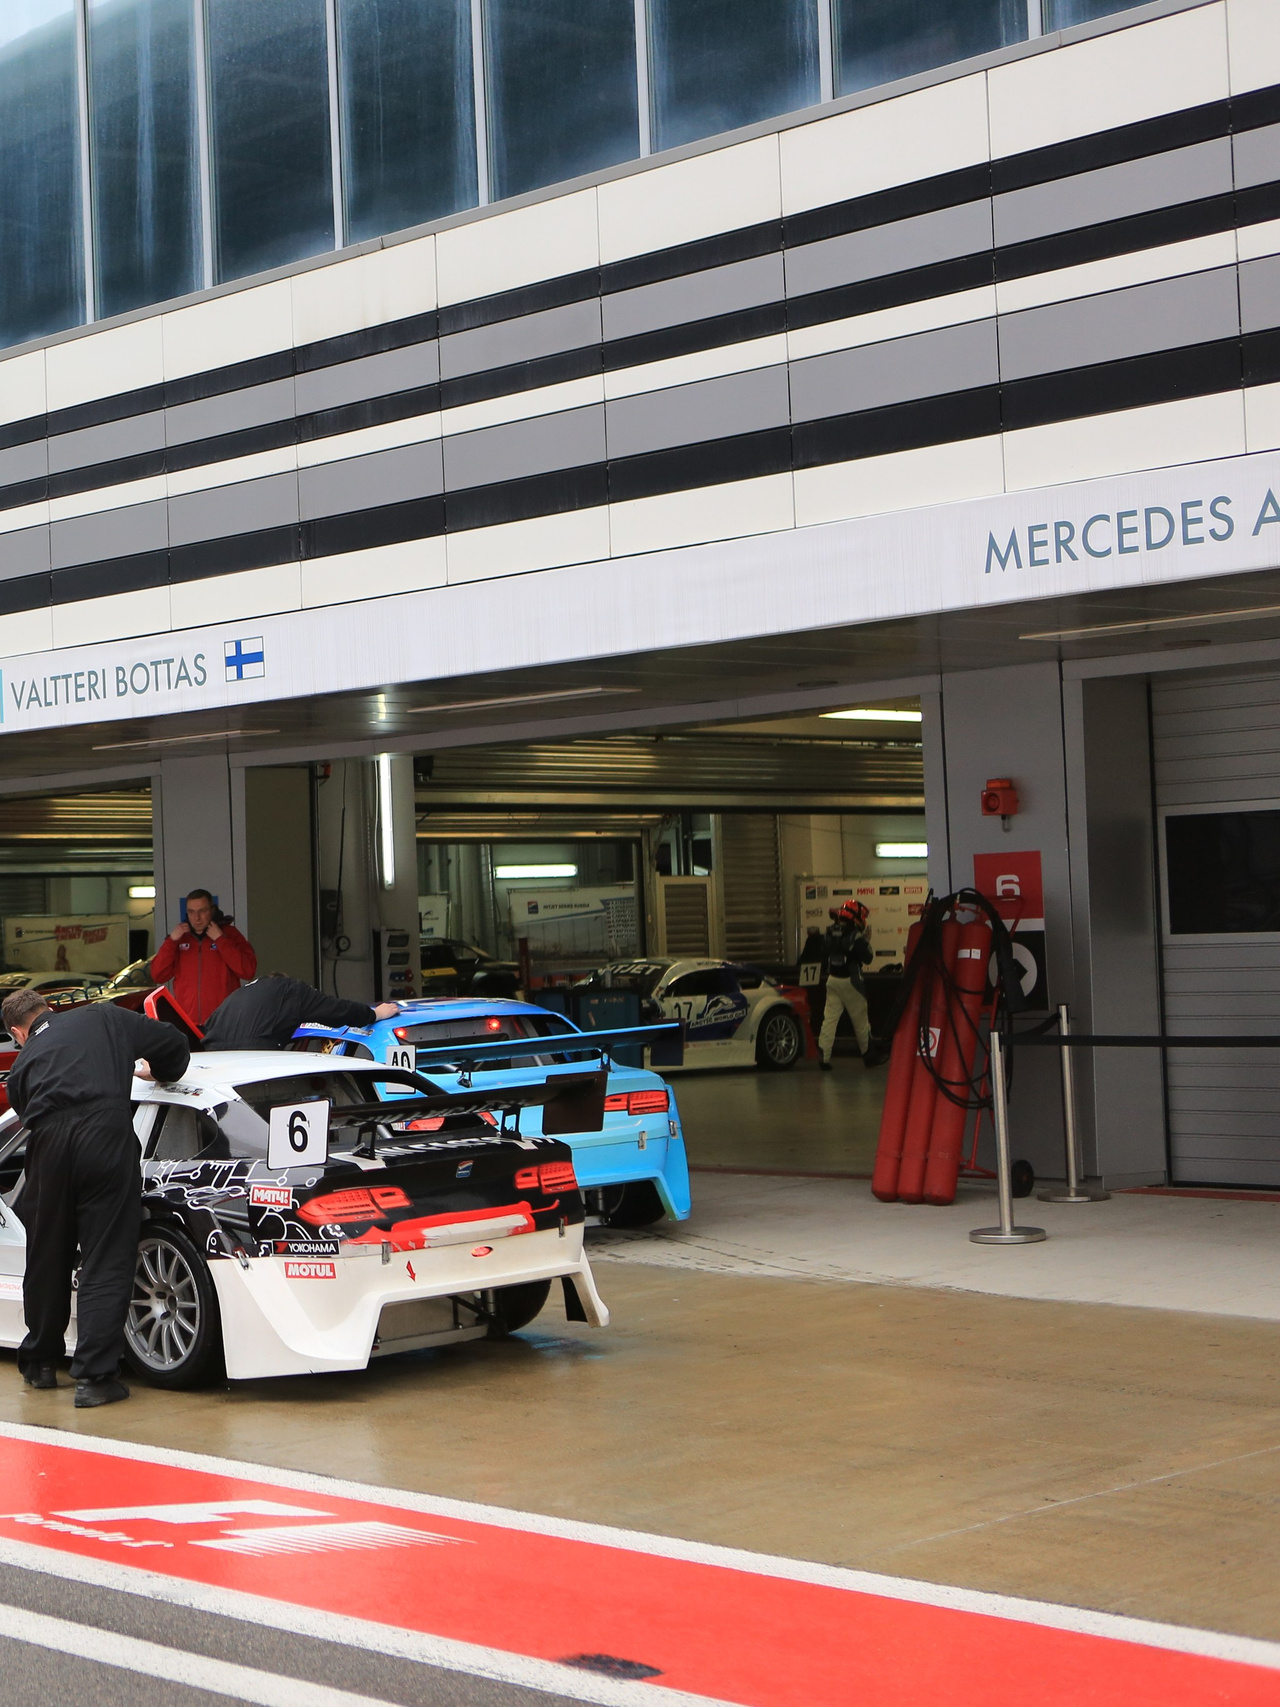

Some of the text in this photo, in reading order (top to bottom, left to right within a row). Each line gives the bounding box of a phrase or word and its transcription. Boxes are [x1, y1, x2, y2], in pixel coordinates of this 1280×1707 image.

[985, 496, 1235, 573] MERCEDES
[10, 669, 107, 711] VALTTERI
[116, 653, 207, 698] BOTTAS
[996, 874, 1019, 900] 6
[803, 966, 817, 982] 17
[674, 1002, 693, 1021] 17
[288, 1110, 310, 1153] 6
[288, 1243, 337, 1253] YOKOHAMA
[287, 1263, 334, 1277] MOTUL
